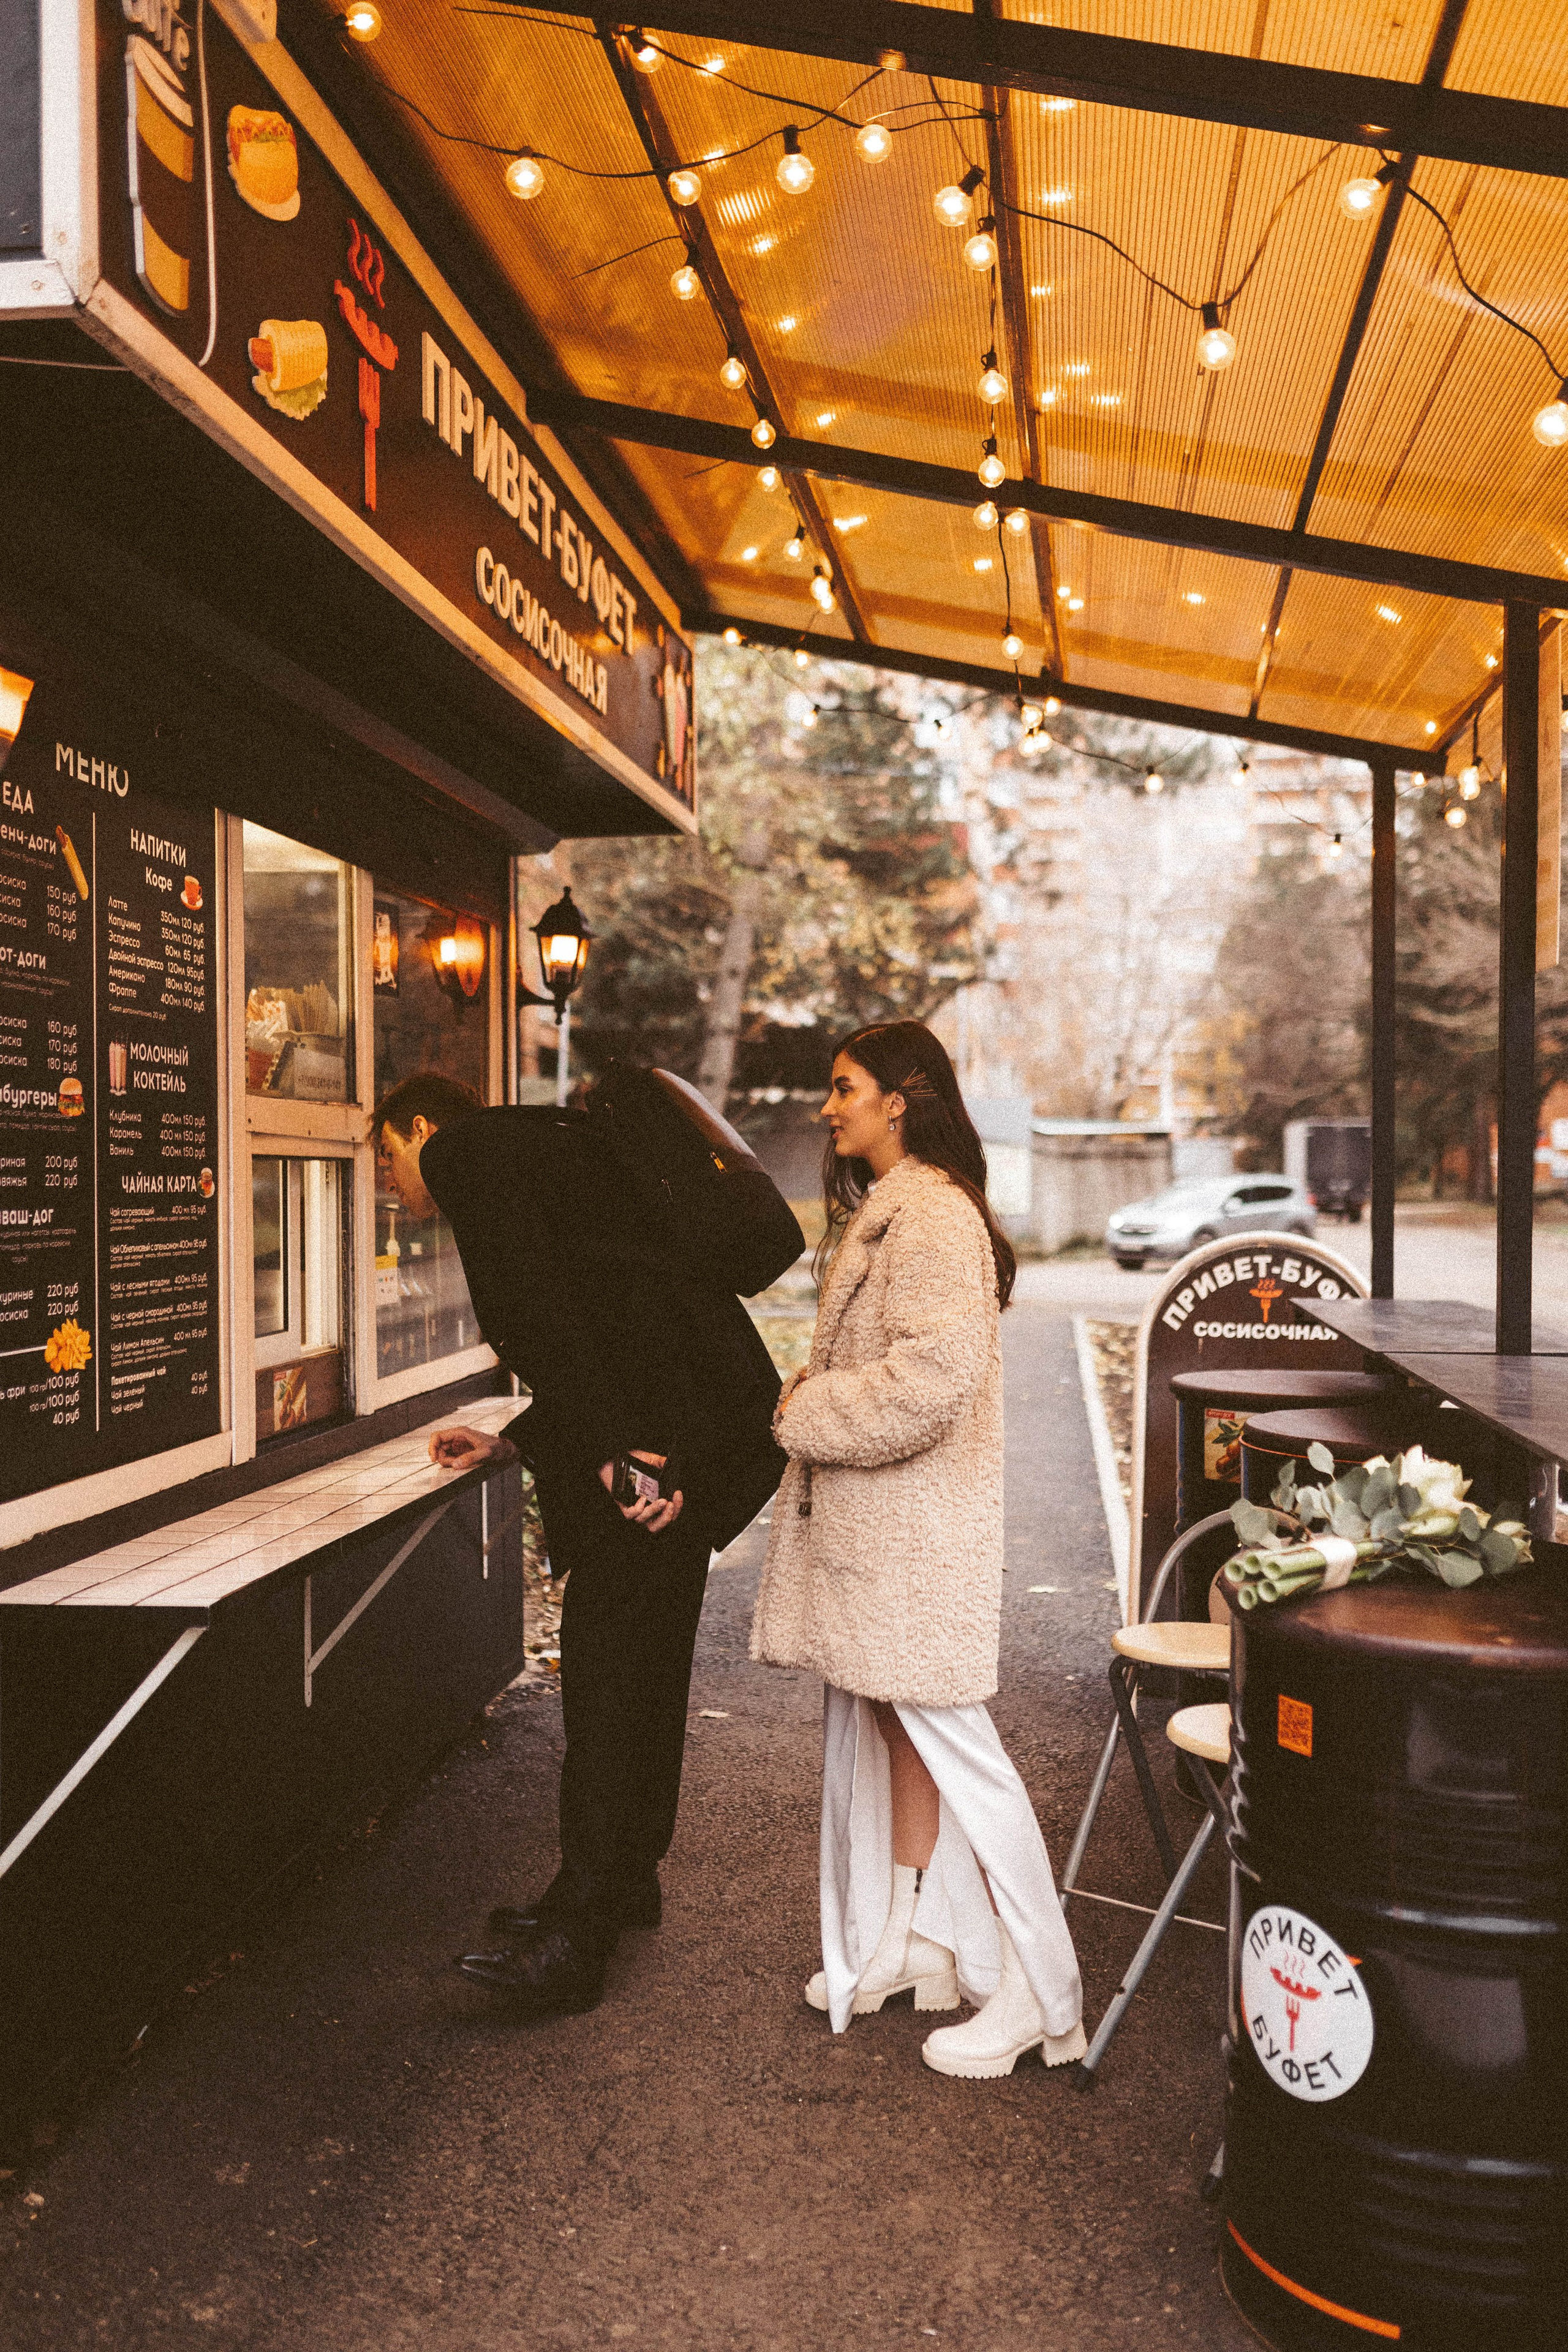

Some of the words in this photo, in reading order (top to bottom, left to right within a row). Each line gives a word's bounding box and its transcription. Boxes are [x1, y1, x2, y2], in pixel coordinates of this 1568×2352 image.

[422, 331, 638, 655] ПРИВЕТ-БУФЕТ
[476, 546, 608, 715] СОСИСОЧНАЯ
[56, 742, 129, 797] МЕНЮ
[3, 781, 34, 814] ЕДА
[130, 828, 186, 868] НАПИТКИ
[146, 866, 172, 892] Кофе
[47, 885, 60, 899] 150
[62, 892, 77, 905] руб
[47, 903, 60, 918] 160
[62, 910, 77, 923] руб
[108, 895, 128, 911] Латте
[160, 910, 180, 926] 350мл
[181, 917, 192, 929] 120
[47, 922, 60, 936] 170
[62, 929, 77, 942] руб
[108, 913, 141, 932] Капучино
[161, 927, 181, 942] 350мл
[182, 933, 192, 945] 120
[108, 930, 140, 948] Эспрессо
[165, 945, 181, 959] 60мл
[184, 949, 190, 961] 65
[108, 948, 135, 964] Двойной
[137, 956, 164, 970] эспрессо
[108, 965, 145, 983] Американо
[184, 981, 192, 993] 90
[109, 982, 137, 998] Фраппе
[183, 998, 192, 1009] 140
[48, 1020, 61, 1033] 160
[63, 1025, 77, 1038] руб
[48, 1039, 61, 1052] 170
[63, 1042, 77, 1056] руб
[130, 1042, 189, 1066] МОЛОЧНЫЙ
[47, 1058, 61, 1070] 180
[63, 1060, 77, 1074] руб
[134, 1070, 186, 1093] КОКТЕЙЛЬ
[0, 1084, 57, 1109] бургеры
[109, 1110, 141, 1123] Клубника
[183, 1115, 194, 1125] 150
[110, 1126, 142, 1140] Карамель
[160, 1129, 173, 1140] 400
[183, 1131, 194, 1141] 150
[110, 1144, 134, 1156] Ваниль
[183, 1147, 194, 1157] 150
[45, 1156, 61, 1167] 200
[64, 1156, 77, 1170] руб
[45, 1174, 60, 1186] 220
[64, 1175, 78, 1188] руб
[122, 1171, 164, 1193] ЧАЙНАЯ
[167, 1175, 197, 1193] КАРТА
[0, 1209, 54, 1226] ваш-дог
[110, 1208, 120, 1216] Чай
[172, 1205, 183, 1214] 400
[47, 1284, 62, 1297] 220
[64, 1283, 78, 1298] руб
[110, 1282, 121, 1292] Чай
[1162, 1254, 1355, 1331] ПРИВЕТ-БУФ
[47, 1302, 62, 1316] 220
[64, 1300, 78, 1316] руб
[110, 1313, 121, 1322] Чай
[111, 1343, 121, 1352] Чай
[173, 1332, 184, 1341] 400
[7, 1386, 25, 1400] фри
[65, 1372, 79, 1388] руб
[111, 1390, 122, 1400] Чай
[65, 1390, 80, 1406] руб
[53, 1412, 63, 1425] 40
[65, 1408, 80, 1425] руб
[111, 1404, 122, 1414] Чай
[1250, 1917, 1359, 2000] ПРИВЕТ
[1252, 2015, 1343, 2090] БУФЕТ
